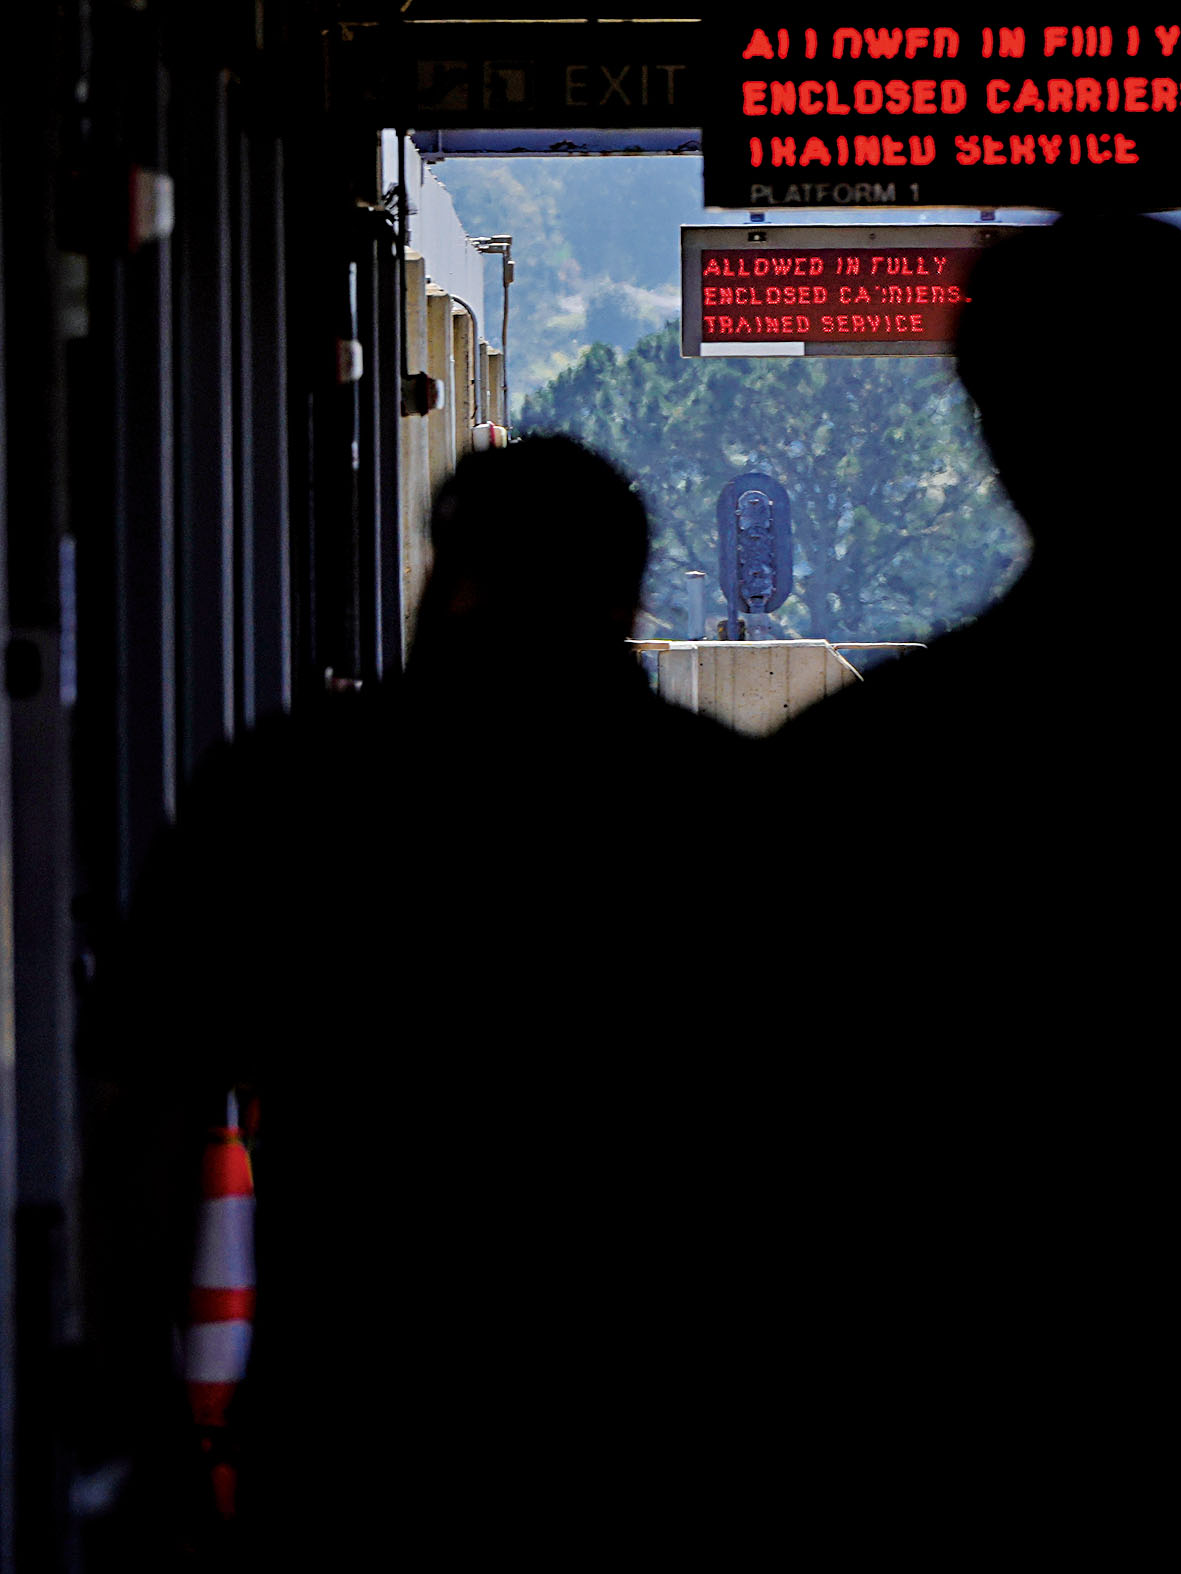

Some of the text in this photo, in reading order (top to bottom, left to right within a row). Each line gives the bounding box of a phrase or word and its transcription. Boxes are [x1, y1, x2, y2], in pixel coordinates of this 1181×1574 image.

[980, 25, 1026, 58] IN
[565, 64, 687, 107] EXIT
[742, 79, 967, 116] ENCLOSED
[750, 182, 920, 204] PLATFORM 1
[703, 256, 947, 277] ALLOWED IN FULLY
[703, 285, 828, 306] ENCLOSED
[703, 313, 924, 334] TRAINED SERVICE
